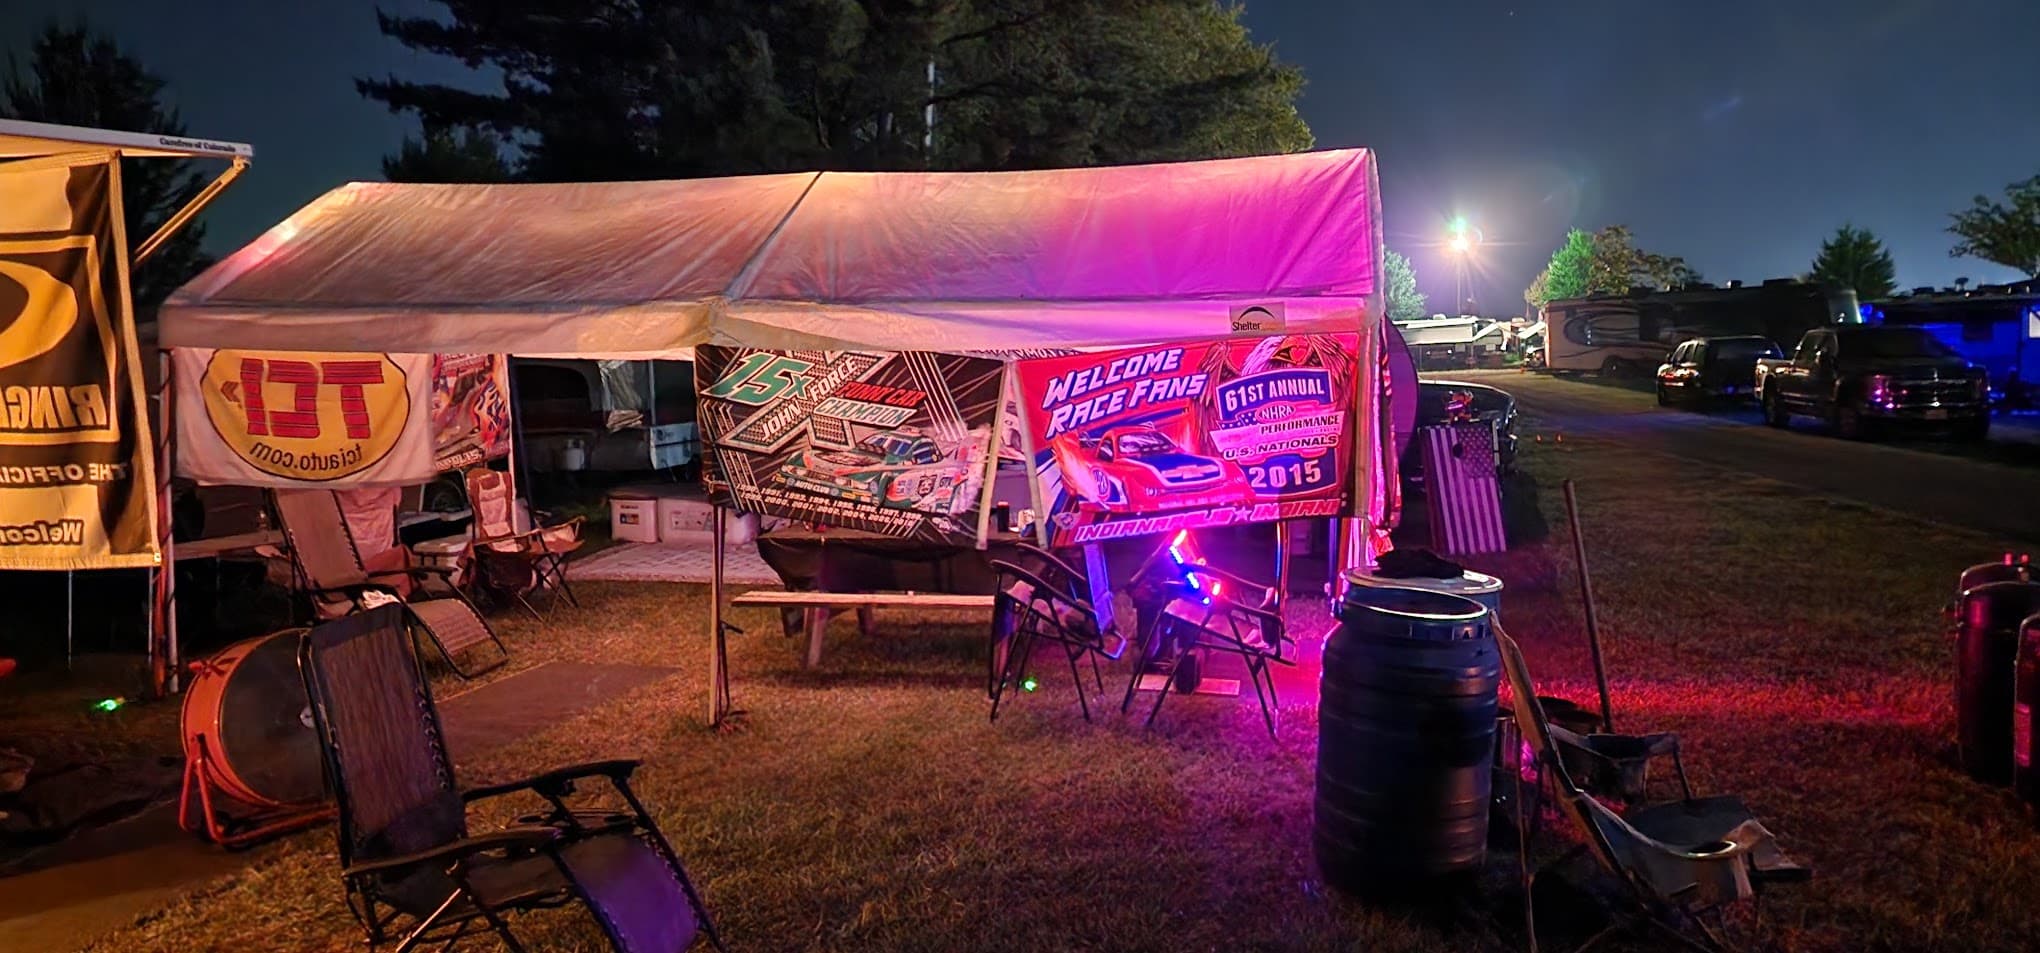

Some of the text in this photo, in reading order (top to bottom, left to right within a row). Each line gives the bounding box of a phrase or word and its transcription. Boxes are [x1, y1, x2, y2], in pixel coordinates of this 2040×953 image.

[1232, 321, 1262, 332] Shelter
[1042, 349, 1183, 408] WELCOME
[762, 358, 858, 441] JOHN FORCE
[836, 382, 927, 408] FUNNY CAR
[1046, 373, 1208, 439] RACE FANS
[1225, 378, 1325, 412] 61ST ANNUAL
[817, 398, 911, 425] CHAMPION
[1260, 404, 1293, 421] NHRA
[1260, 415, 1340, 435] PERFORMANCE
[1225, 435, 1338, 459] U.S. NATIONALS
[794, 480, 830, 494] AUTO CLUB
[1250, 460, 1322, 488] 2015
[1074, 507, 1236, 543] INDIANAPOLIS
